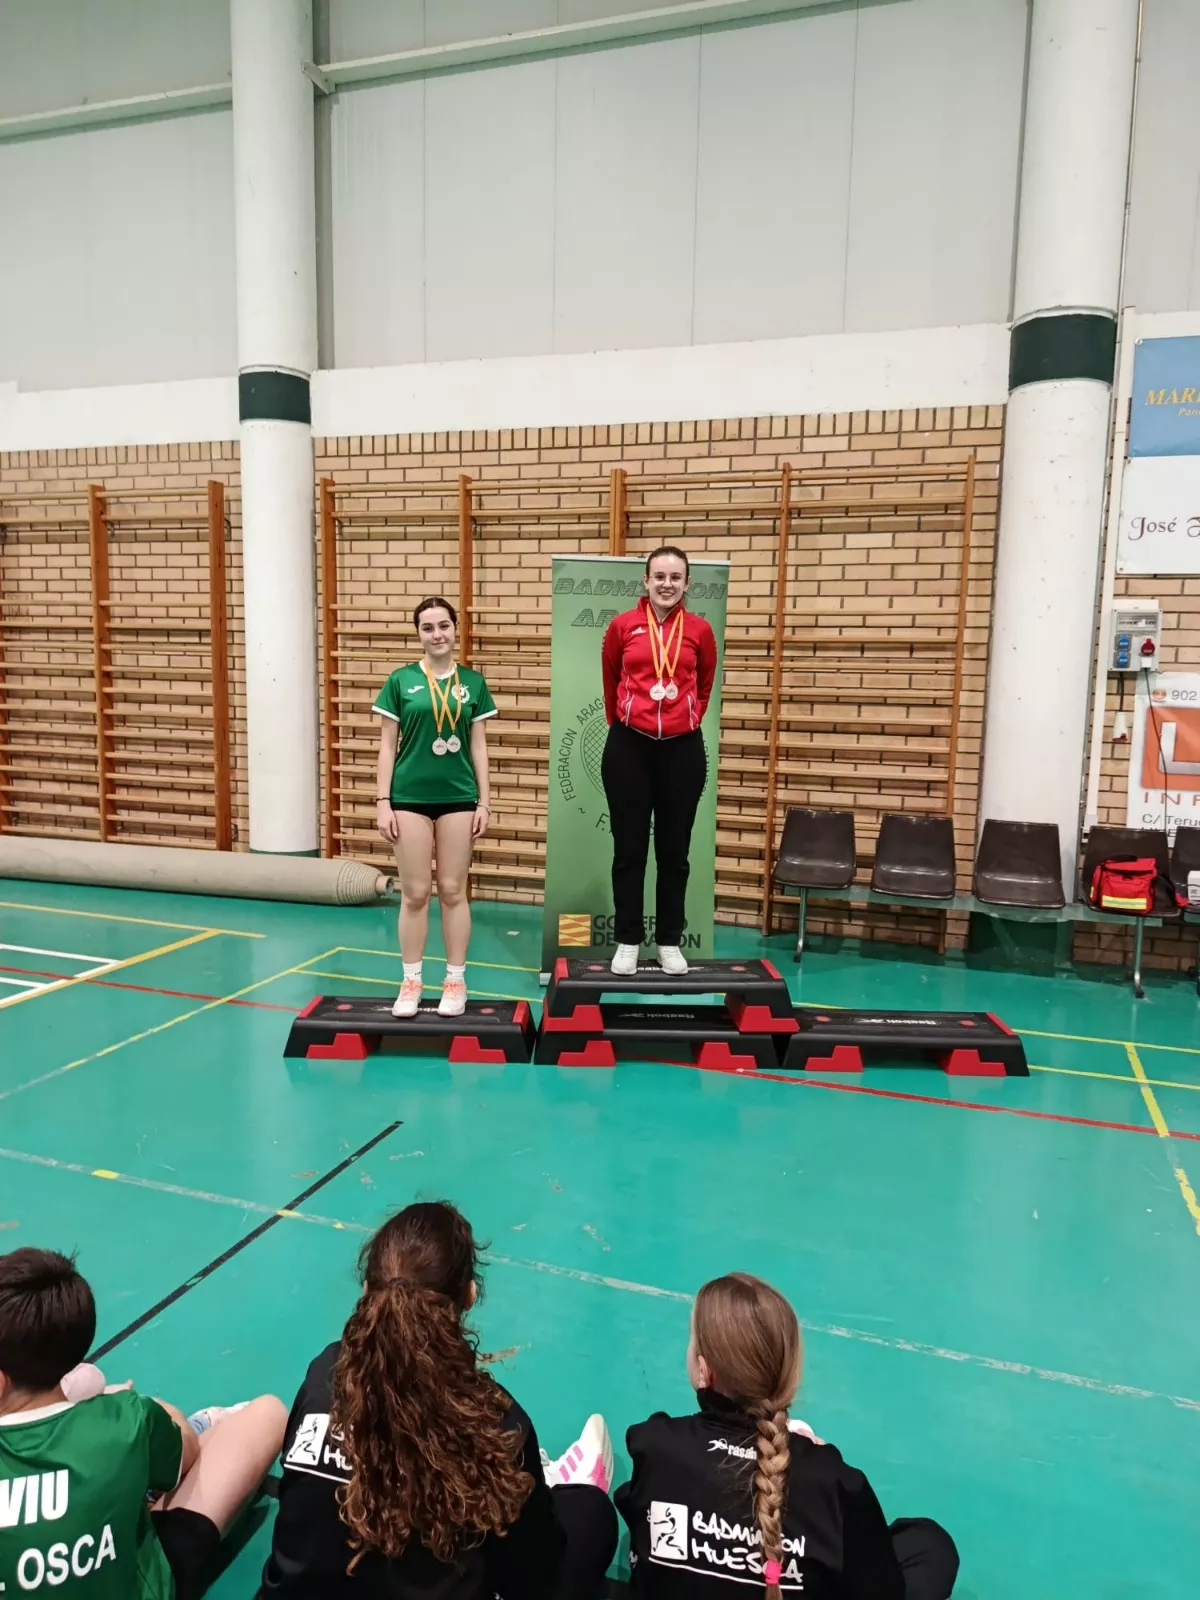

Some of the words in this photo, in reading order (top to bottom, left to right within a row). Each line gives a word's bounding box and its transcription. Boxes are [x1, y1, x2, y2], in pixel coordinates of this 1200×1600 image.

[1128, 516, 1178, 541] José
[553, 577, 727, 600] BADMON
[1171, 689, 1198, 701] 902
[557, 727, 578, 802] FEDERACION
[1164, 815, 1200, 827] Teru
[17, 1523, 117, 1591] OSCA
